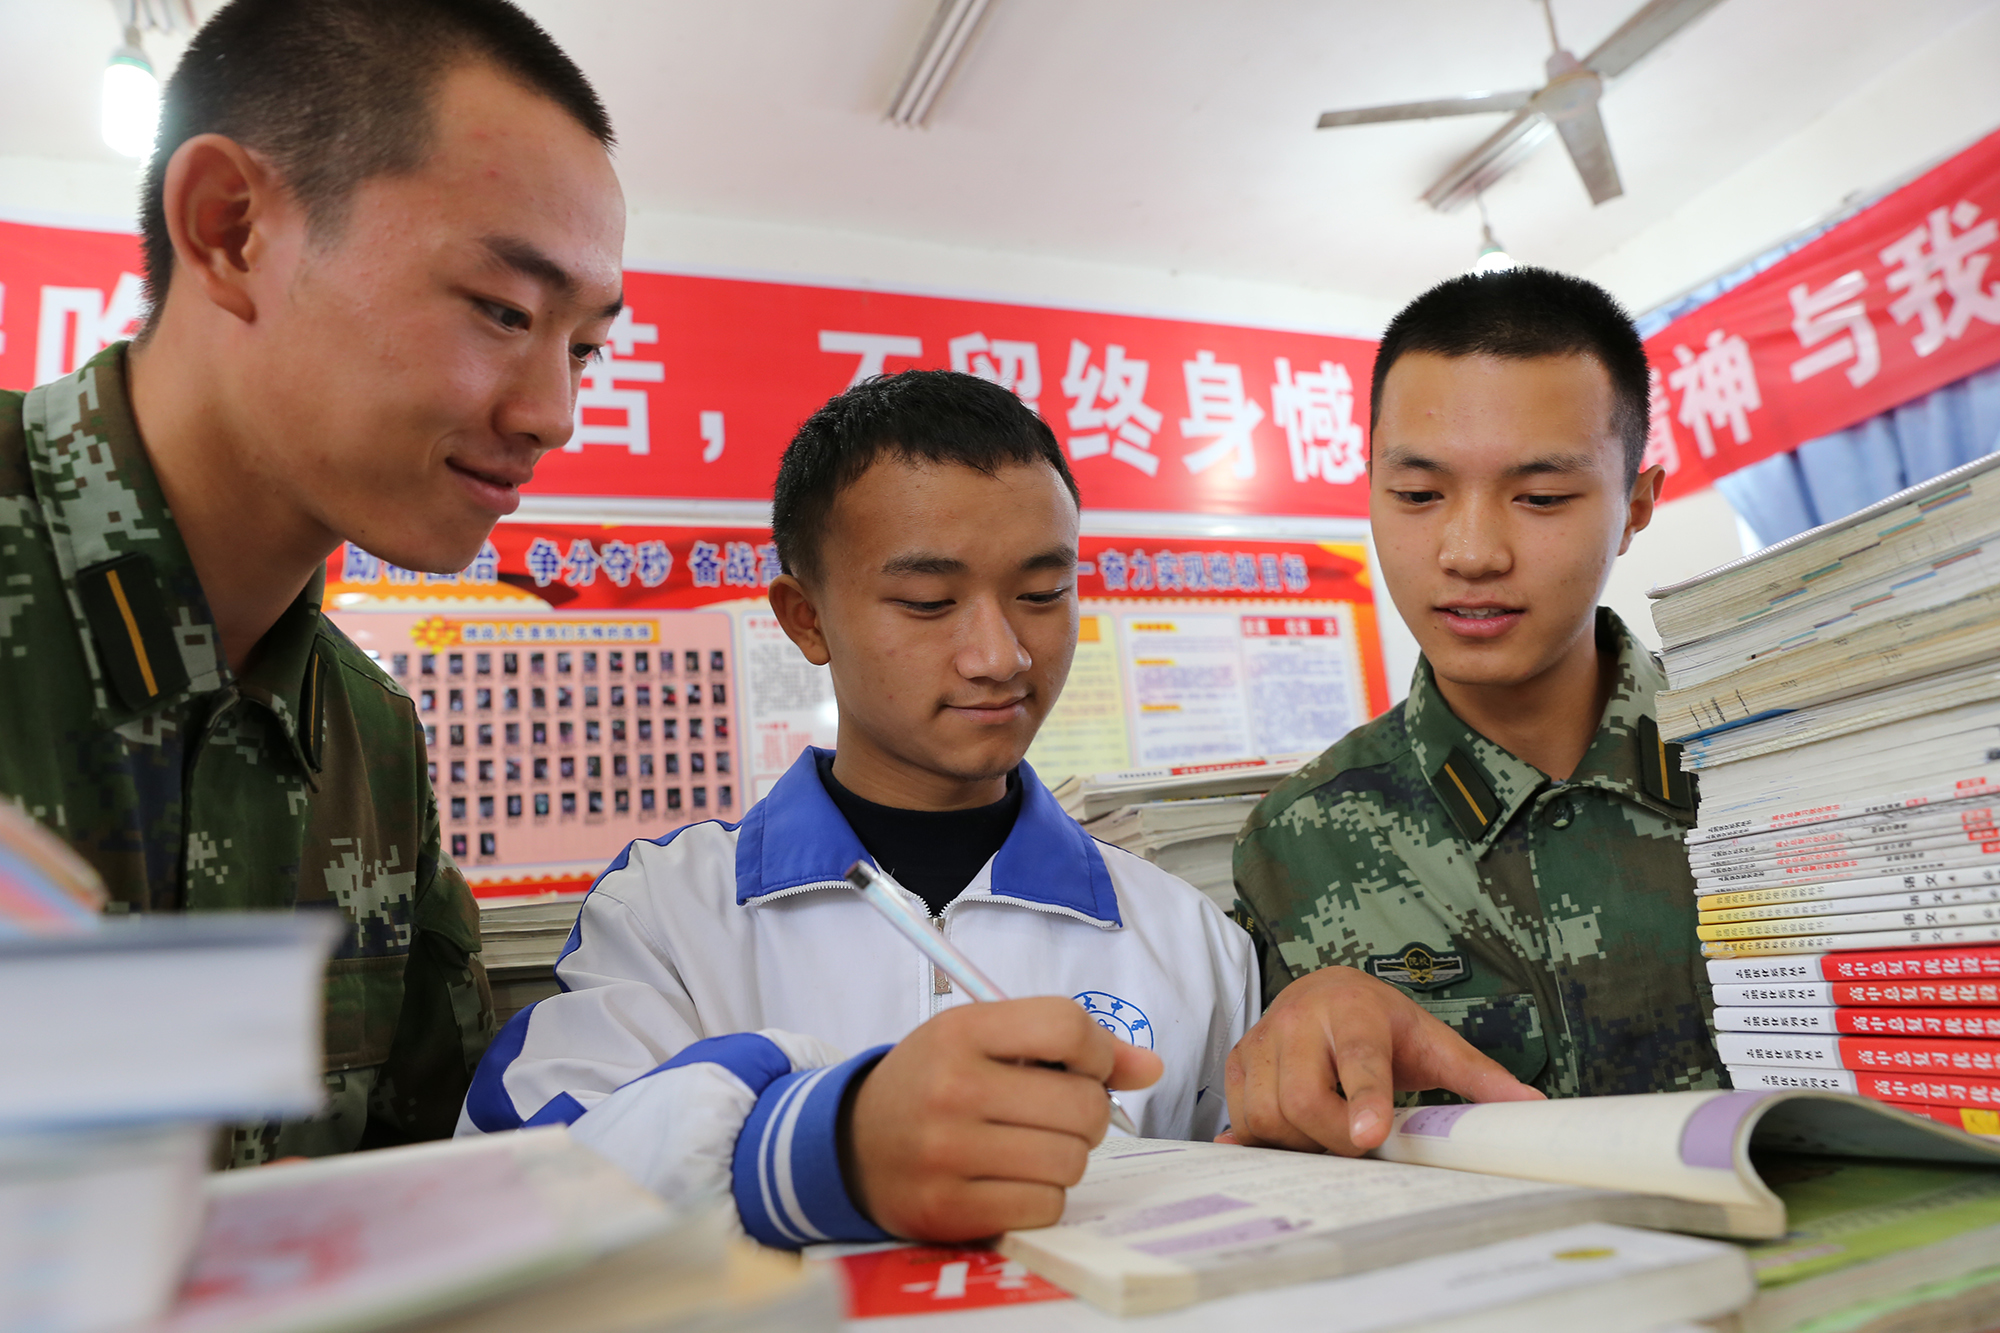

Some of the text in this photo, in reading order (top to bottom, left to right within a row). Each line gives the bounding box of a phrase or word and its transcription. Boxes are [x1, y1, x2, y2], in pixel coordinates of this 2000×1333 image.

[525, 536, 674, 588] 争分夺秒
[1849, 984, 2000, 1002] 高中总复习优化设
